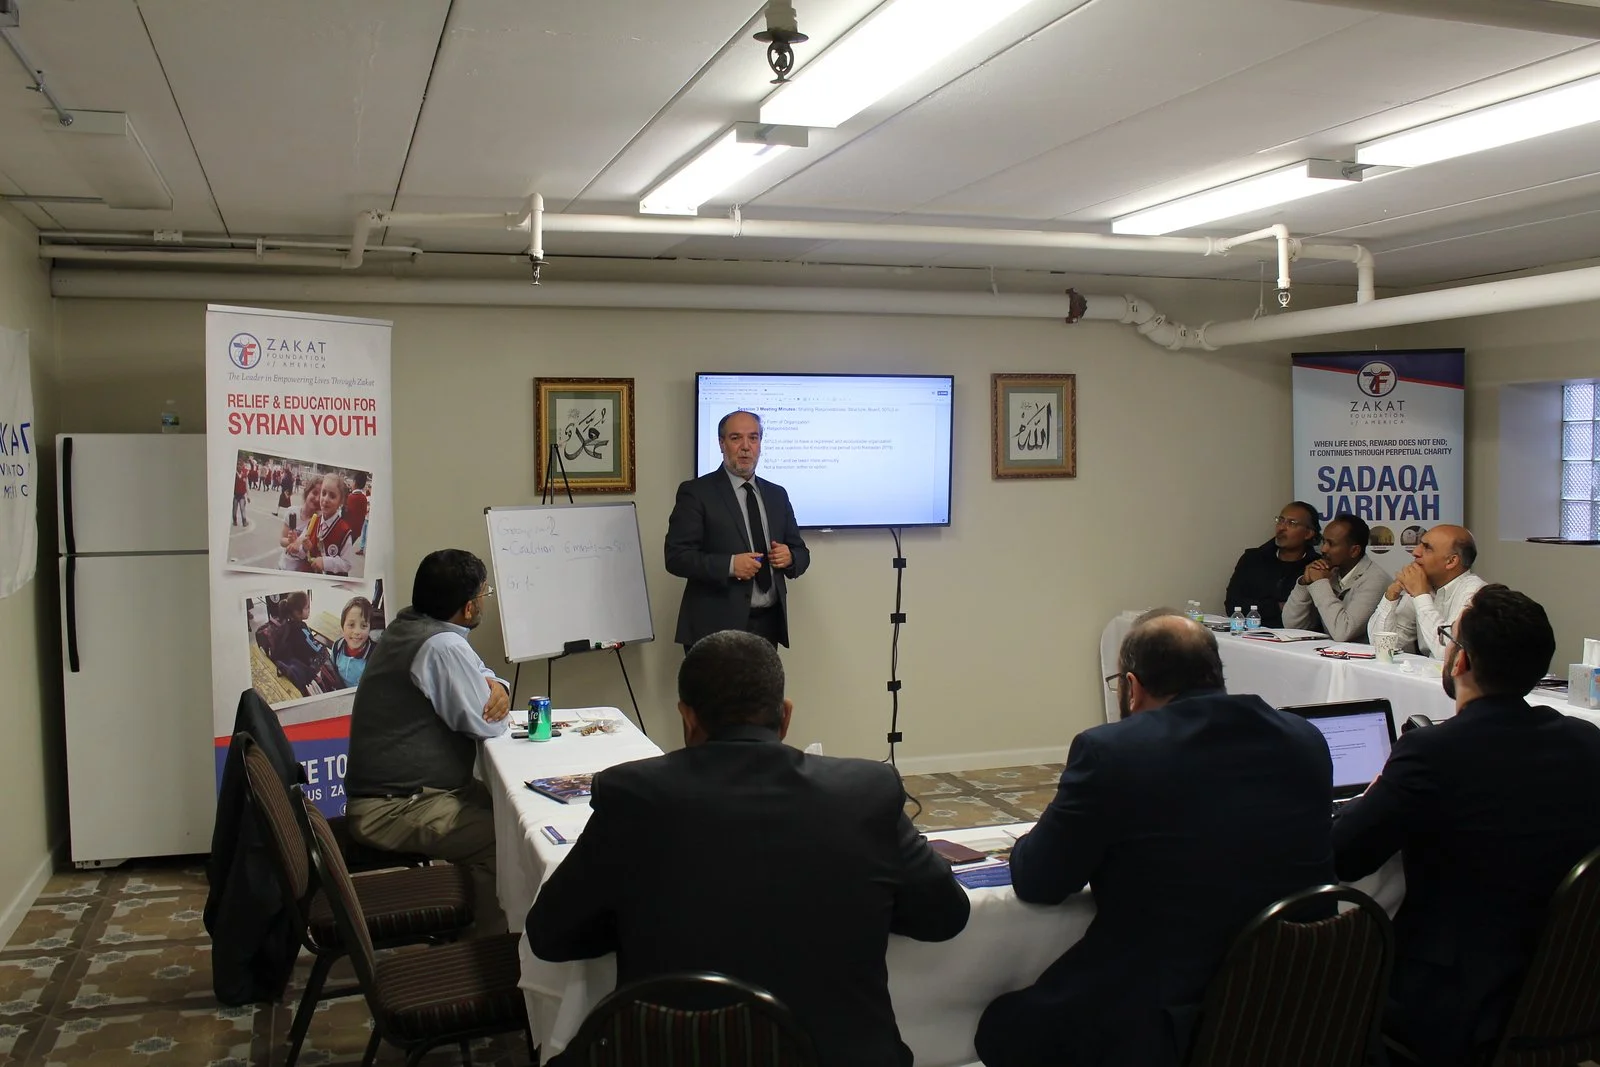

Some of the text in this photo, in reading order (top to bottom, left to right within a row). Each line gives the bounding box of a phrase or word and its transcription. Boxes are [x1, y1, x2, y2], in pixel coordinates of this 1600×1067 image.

[266, 338, 327, 354] ZAKAT
[266, 353, 326, 361] FOUNDATION
[283, 361, 326, 369] AMERICA
[228, 372, 240, 381] The
[241, 373, 264, 382] Leader
[273, 374, 314, 386] Empowering
[314, 376, 330, 385] Lives
[331, 377, 356, 387] Through
[357, 378, 375, 387] Zakat
[227, 393, 376, 411] RELIEF & EDUCATION FOR
[1350, 400, 1405, 412] ZAKAT
[228, 412, 377, 436] SYRIAN YOUTH
[1314, 440, 1334, 448] WHEN
[1349, 439, 1369, 448] ENDS,
[1370, 439, 1398, 447] REWARD
[1399, 438, 1417, 446] DOES
[1417, 438, 1430, 446] NOT
[1432, 438, 1448, 446] END;
[1317, 449, 1353, 457] CONTINUES
[1354, 448, 1385, 456] THROUGH
[1385, 448, 1423, 456] PERPETUAL
[1424, 447, 1453, 455] CHARITY
[1317, 465, 1439, 493] SADAQA
[1318, 494, 1441, 522] JARIYAH
[300, 754, 348, 784] E TO
[307, 789, 322, 801] US
